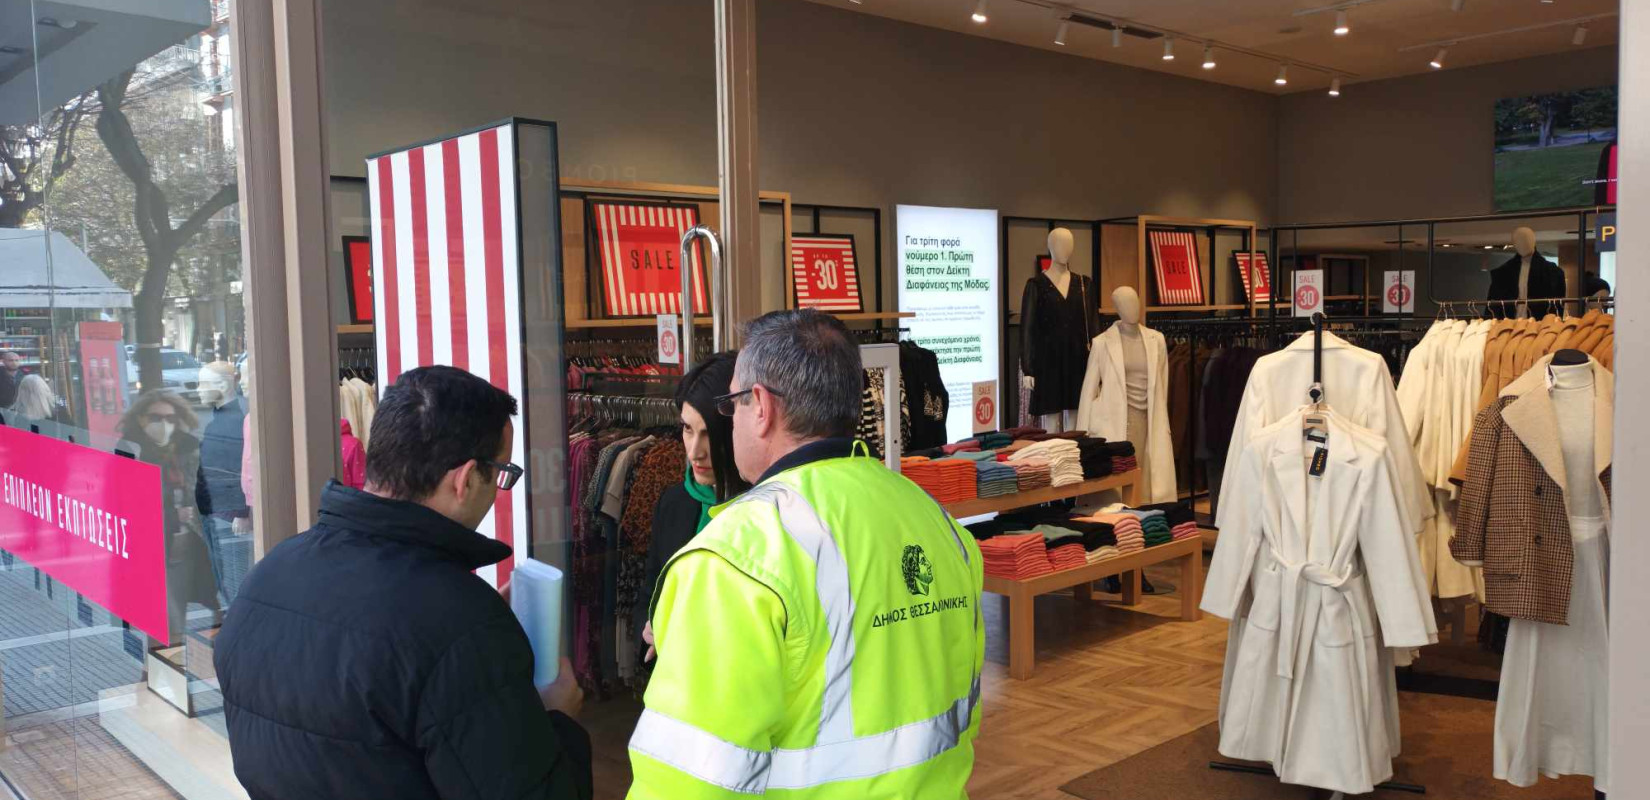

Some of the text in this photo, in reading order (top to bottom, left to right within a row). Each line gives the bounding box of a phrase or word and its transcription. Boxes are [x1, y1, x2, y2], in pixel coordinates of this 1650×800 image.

[905, 235, 961, 249] Για τρίτη φορά
[630, 249, 675, 270] SALE
[905, 250, 939, 262] νούμερο
[948, 251, 974, 263] Πρώτη
[905, 264, 970, 277] θέση στον Δείκτη
[1166, 260, 1188, 275] SALE
[906, 279, 950, 291] Διαφάνειας
[951, 281, 963, 291] της
[1392, 274, 1407, 283] SAE
[3, 472, 129, 560] ΕΠΙΠΛΕΟΝ ΕΚΠΤΩΣΕΙΣ
[909, 596, 968, 619] ΘΕΣΣΑΟΝΙΚΗΣ
